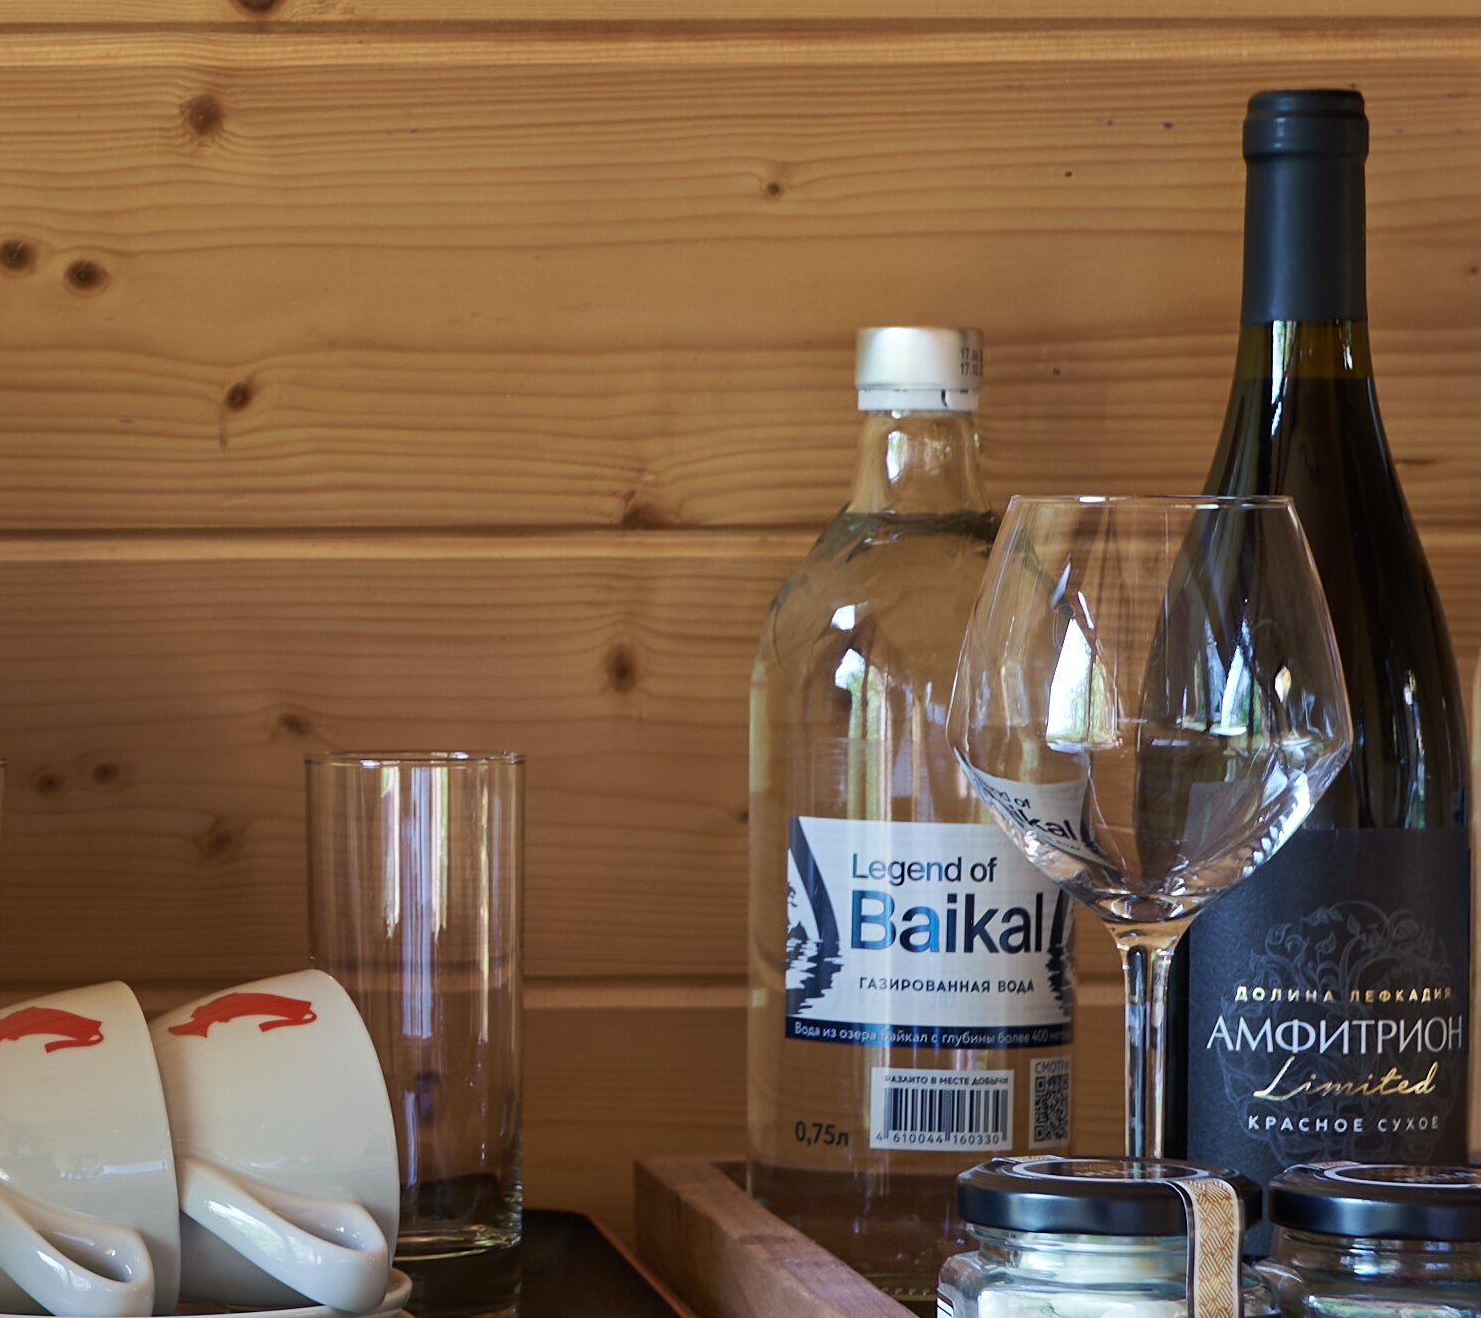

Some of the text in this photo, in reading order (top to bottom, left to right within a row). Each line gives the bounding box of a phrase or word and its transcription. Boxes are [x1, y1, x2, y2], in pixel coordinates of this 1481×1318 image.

[851, 853, 998, 886] Legend of
[850, 889, 1044, 954] Baikal
[859, 977, 1035, 994] ГАЗИРОВАННАЯ ВОДА
[1234, 985, 1452, 1003] ДОЛИНА ЛЕФКАДИЯ
[794, 1021, 820, 1037] Вода
[822, 1028, 837, 1038] из
[839, 1028, 877, 1043] озера
[880, 1029, 928, 1043] Байкал
[931, 1034, 938, 1043] с
[942, 1030, 995, 1046] глубины
[997, 1031, 1029, 1043] более
[1032, 1028, 1049, 1042] 400
[1206, 1013, 1463, 1055] АМФИТРИОН
[930, 1077, 937, 1085] В
[939, 1077, 969, 1086] МЕСТЕ
[1253, 1055, 1439, 1102] Limited
[794, 1120, 850, 1147] 0,75л
[1248, 1114, 1439, 1132] КРАСНОЕ СУХОЕ
[893, 1132, 943, 1144] 610044
[953, 1133, 999, 1145] 160330
